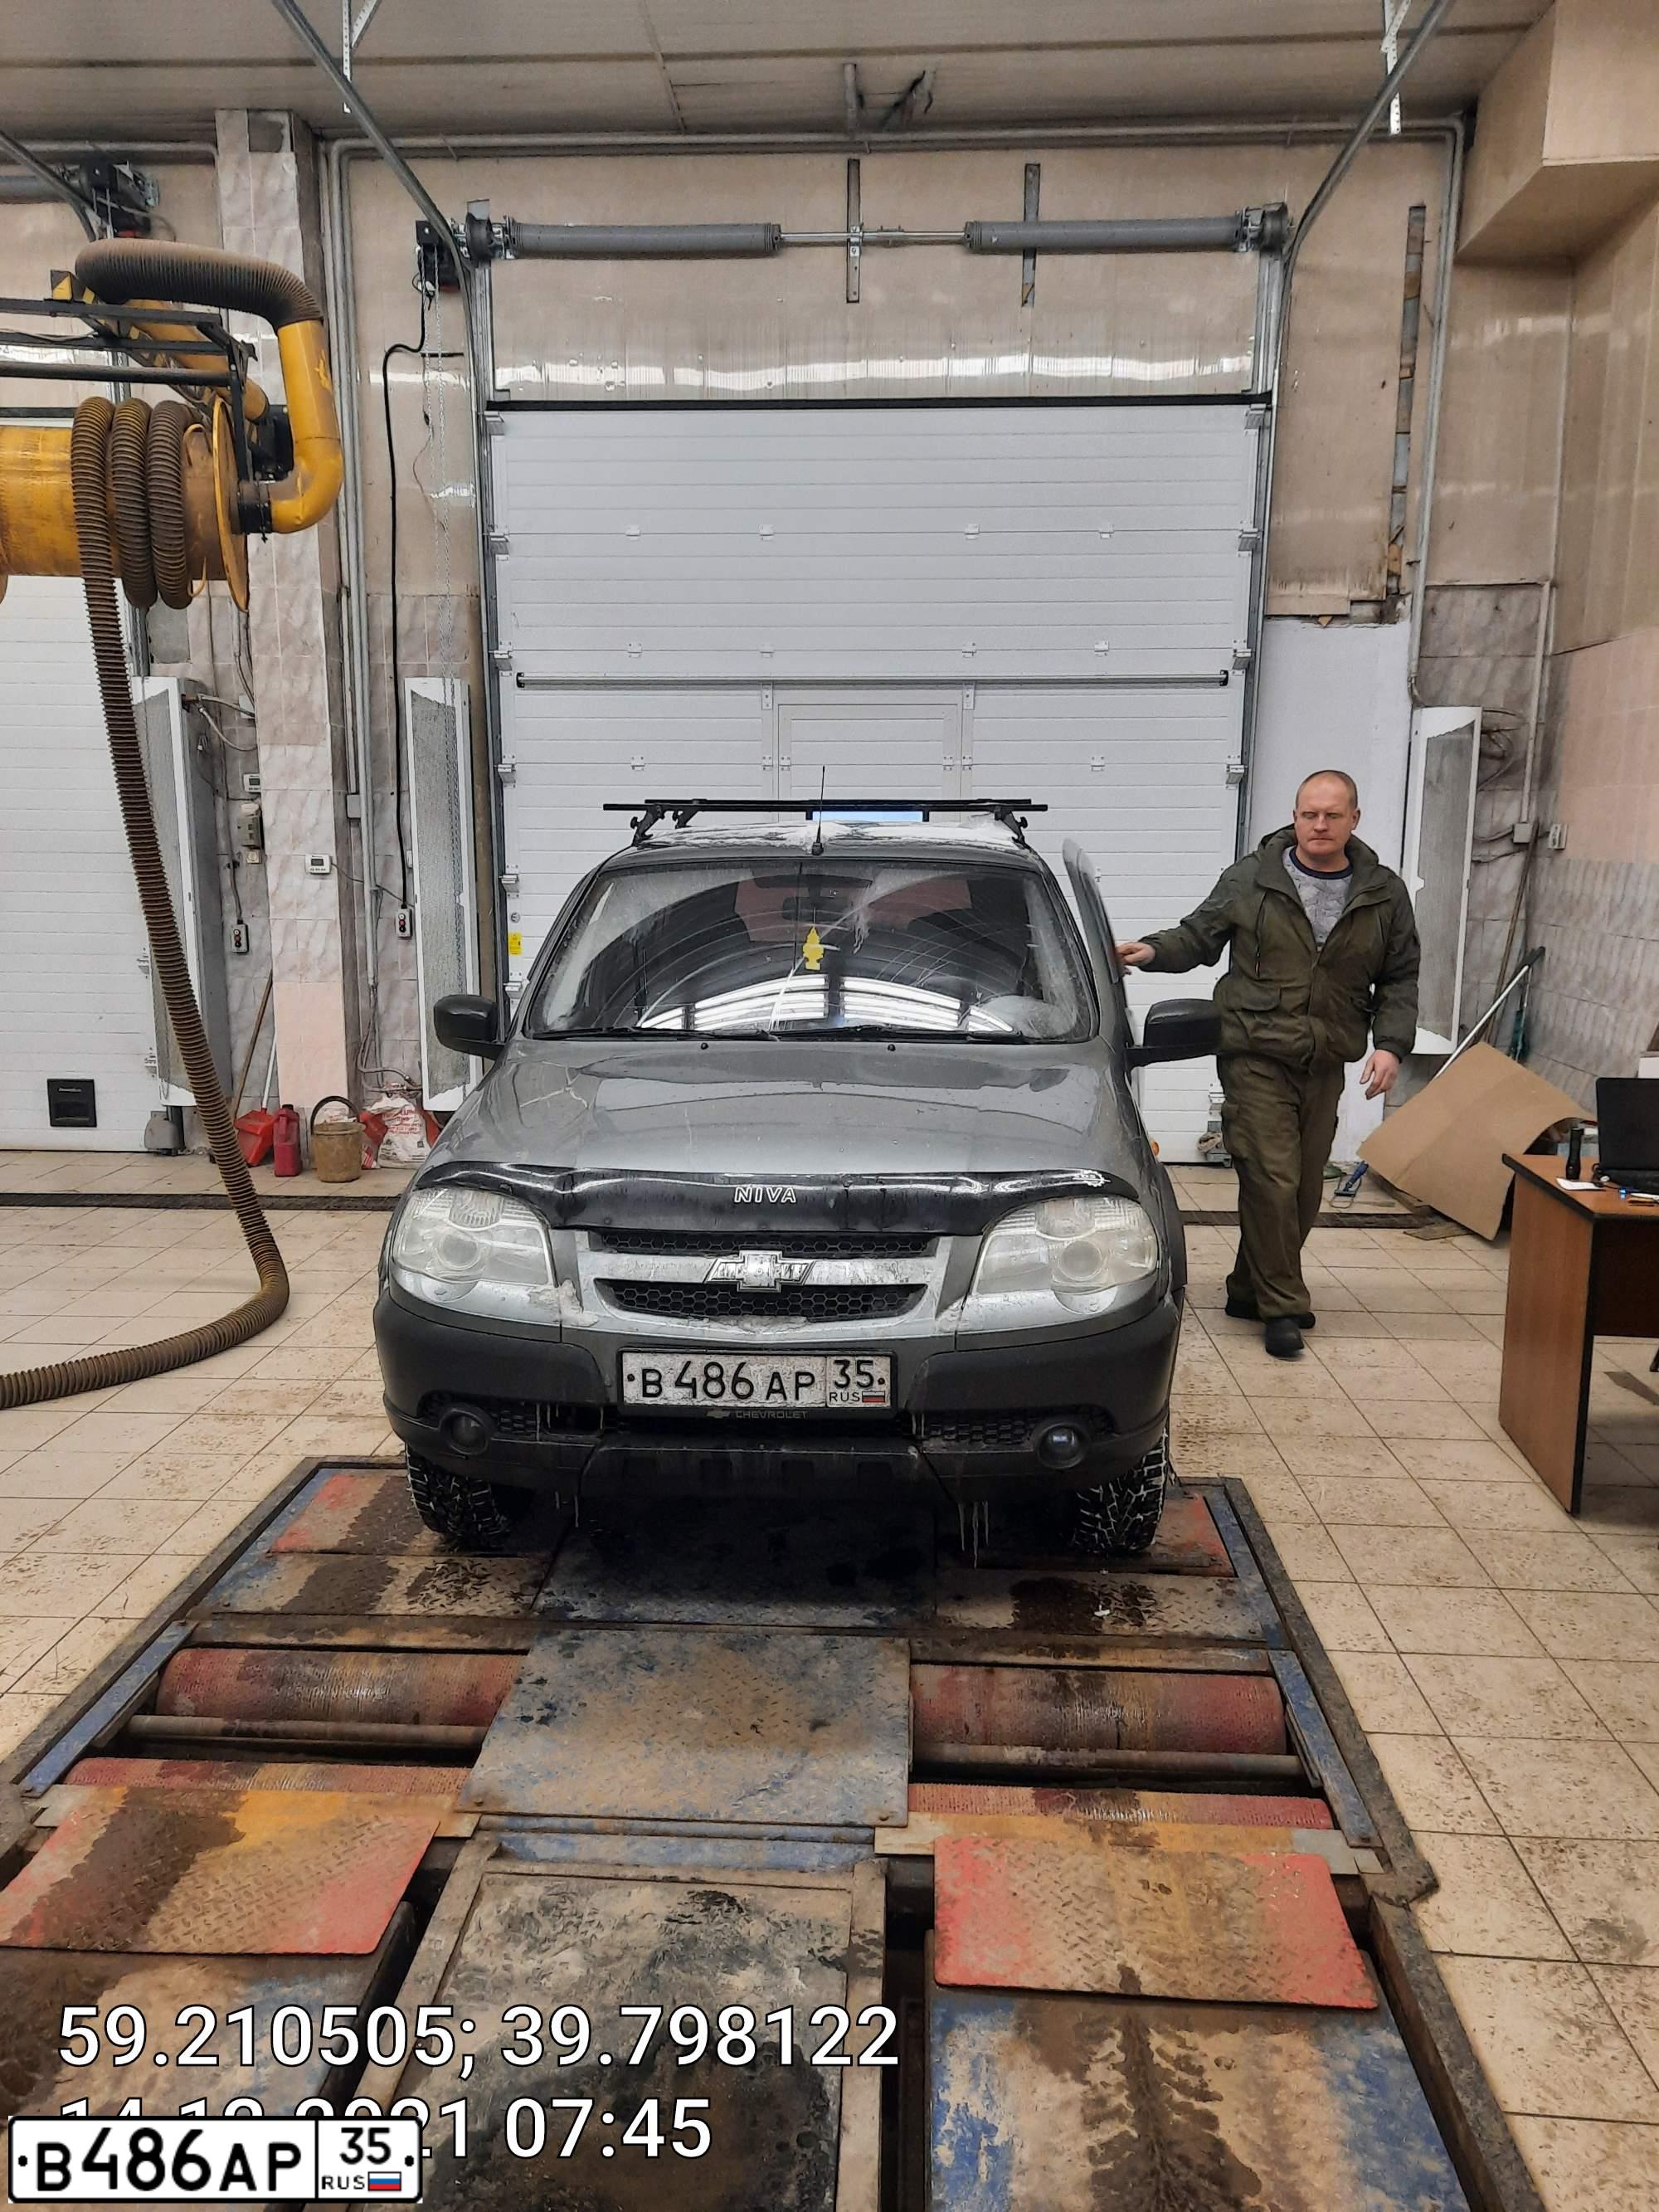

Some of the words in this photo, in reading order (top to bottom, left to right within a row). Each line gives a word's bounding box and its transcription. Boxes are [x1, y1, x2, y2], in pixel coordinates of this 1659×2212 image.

[734, 1186, 796, 1203] NIVA
[833, 1359, 874, 1389] 35
[829, 1391, 861, 1403] RUS
[736, 1410, 810, 1420] CHEVROLET
